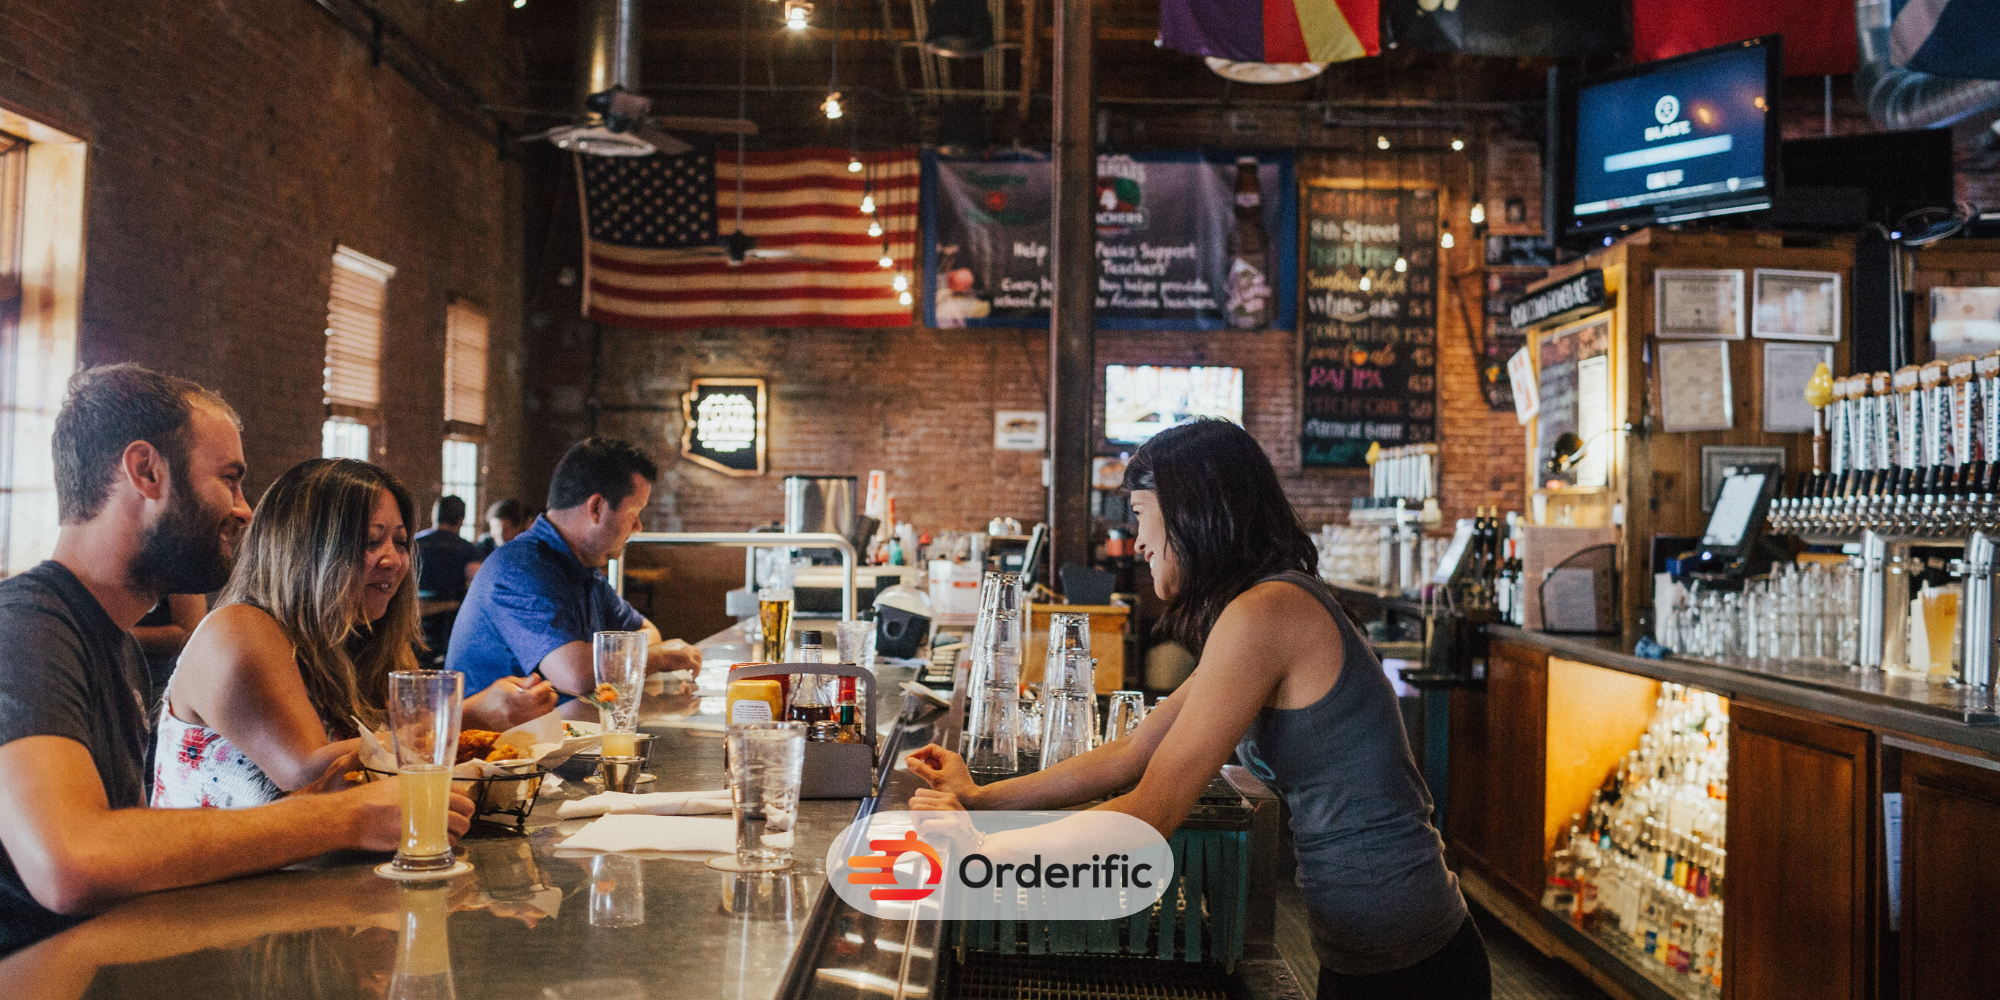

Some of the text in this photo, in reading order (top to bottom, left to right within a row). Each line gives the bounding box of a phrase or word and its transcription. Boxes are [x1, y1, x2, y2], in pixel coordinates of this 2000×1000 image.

[1341, 219, 1399, 242] Street
[1013, 241, 1048, 267] Help
[1139, 243, 1196, 267] Support
[1352, 368, 1382, 389] IPA
